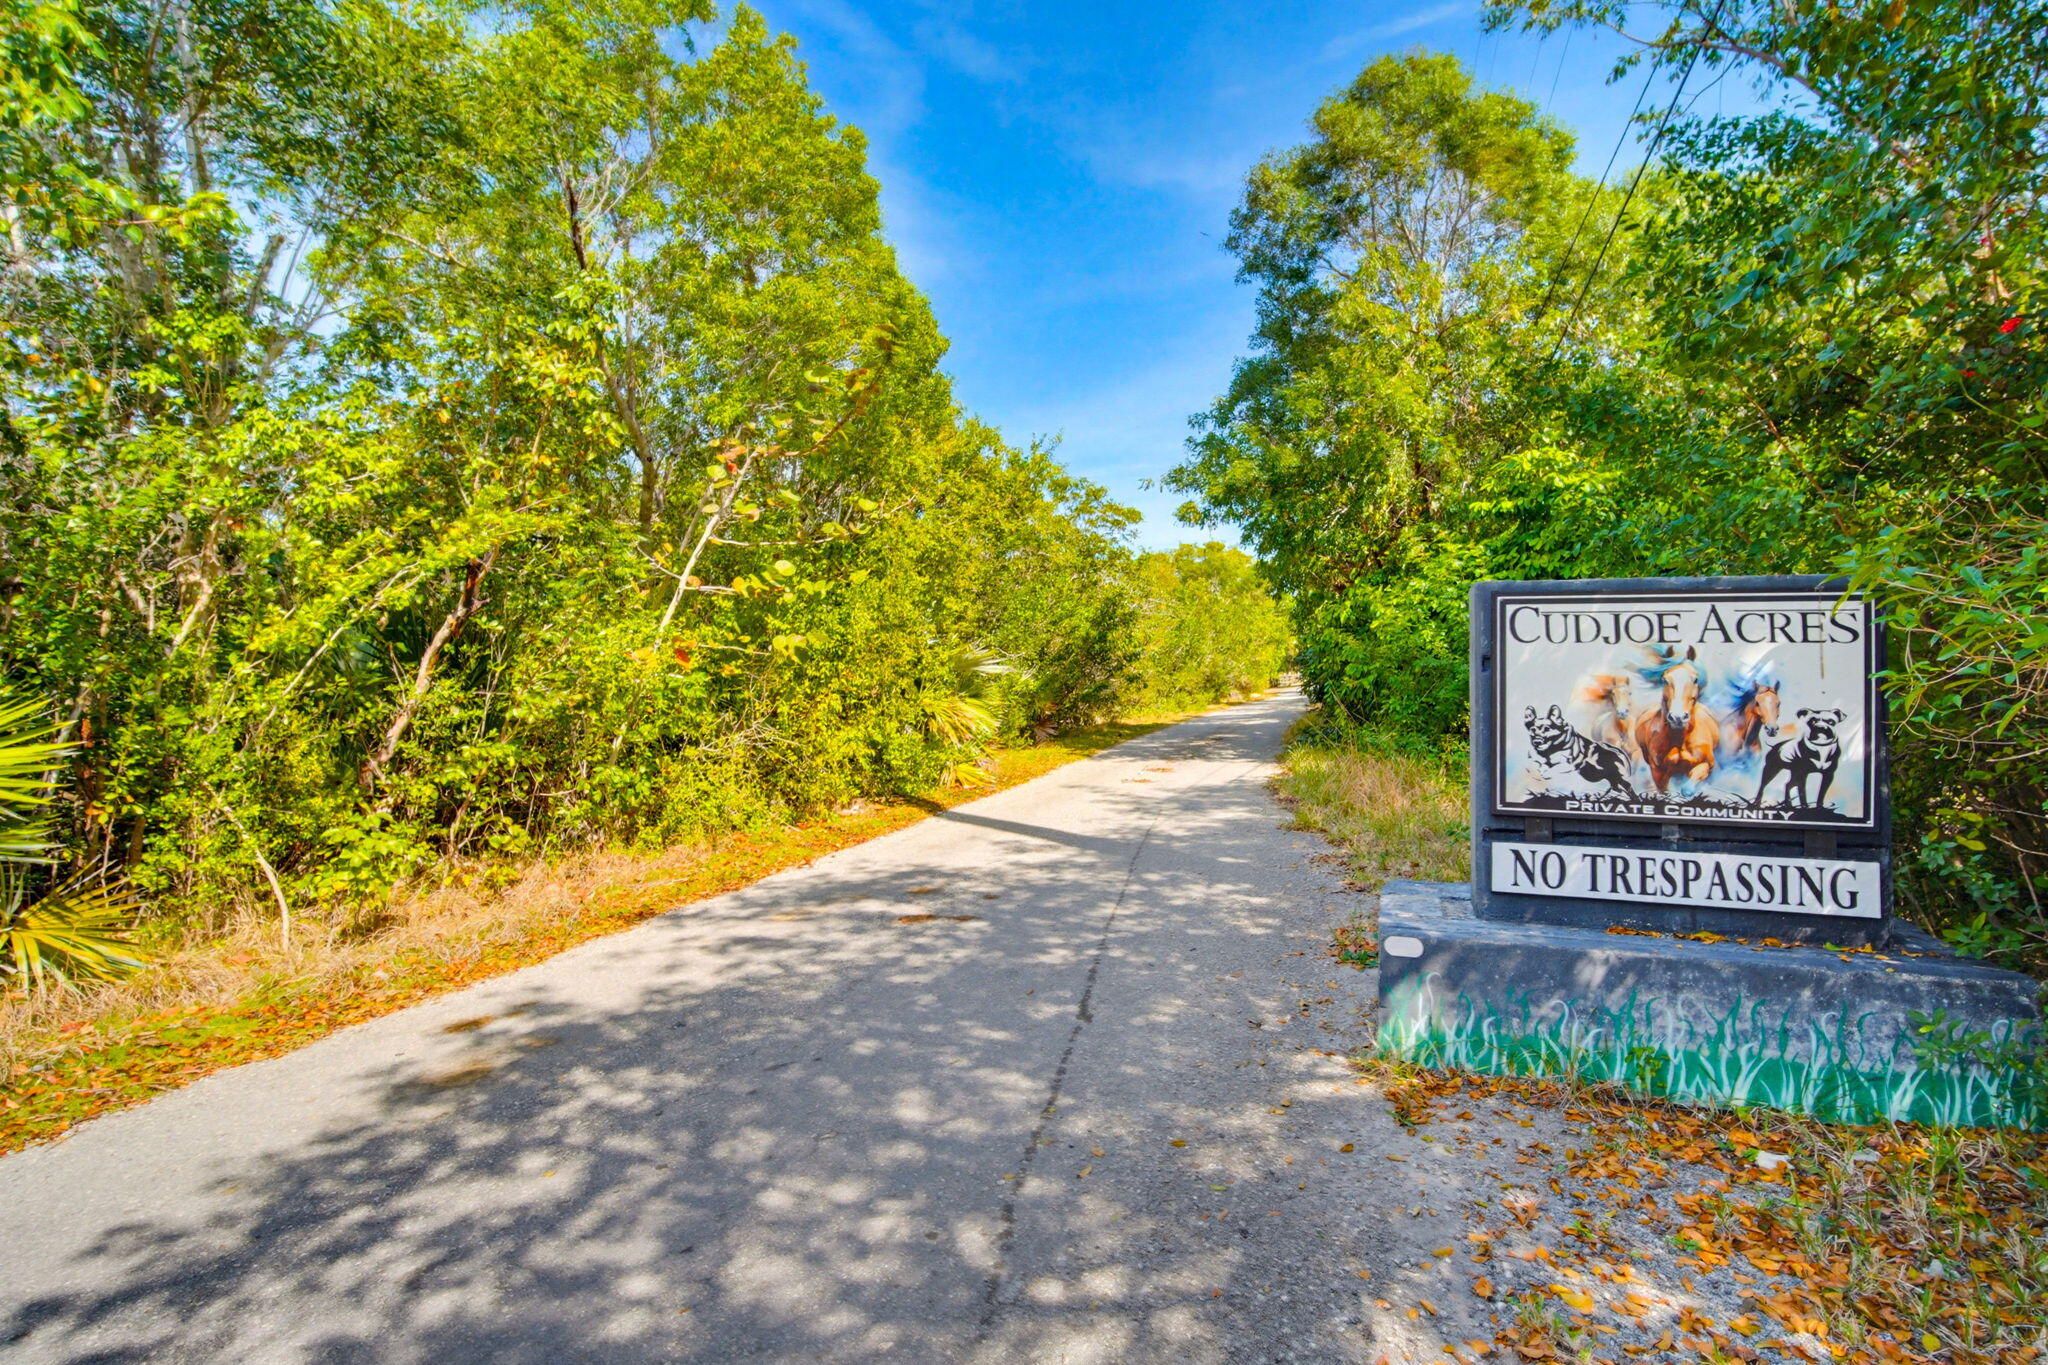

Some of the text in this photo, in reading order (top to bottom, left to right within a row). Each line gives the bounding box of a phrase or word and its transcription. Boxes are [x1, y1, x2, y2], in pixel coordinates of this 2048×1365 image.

[1509, 604, 1860, 644] CUDJOE ACRES
[1565, 800, 1795, 821] PRIVATE COMMUNITY
[1510, 848, 1860, 910] NO TRESPASSING
